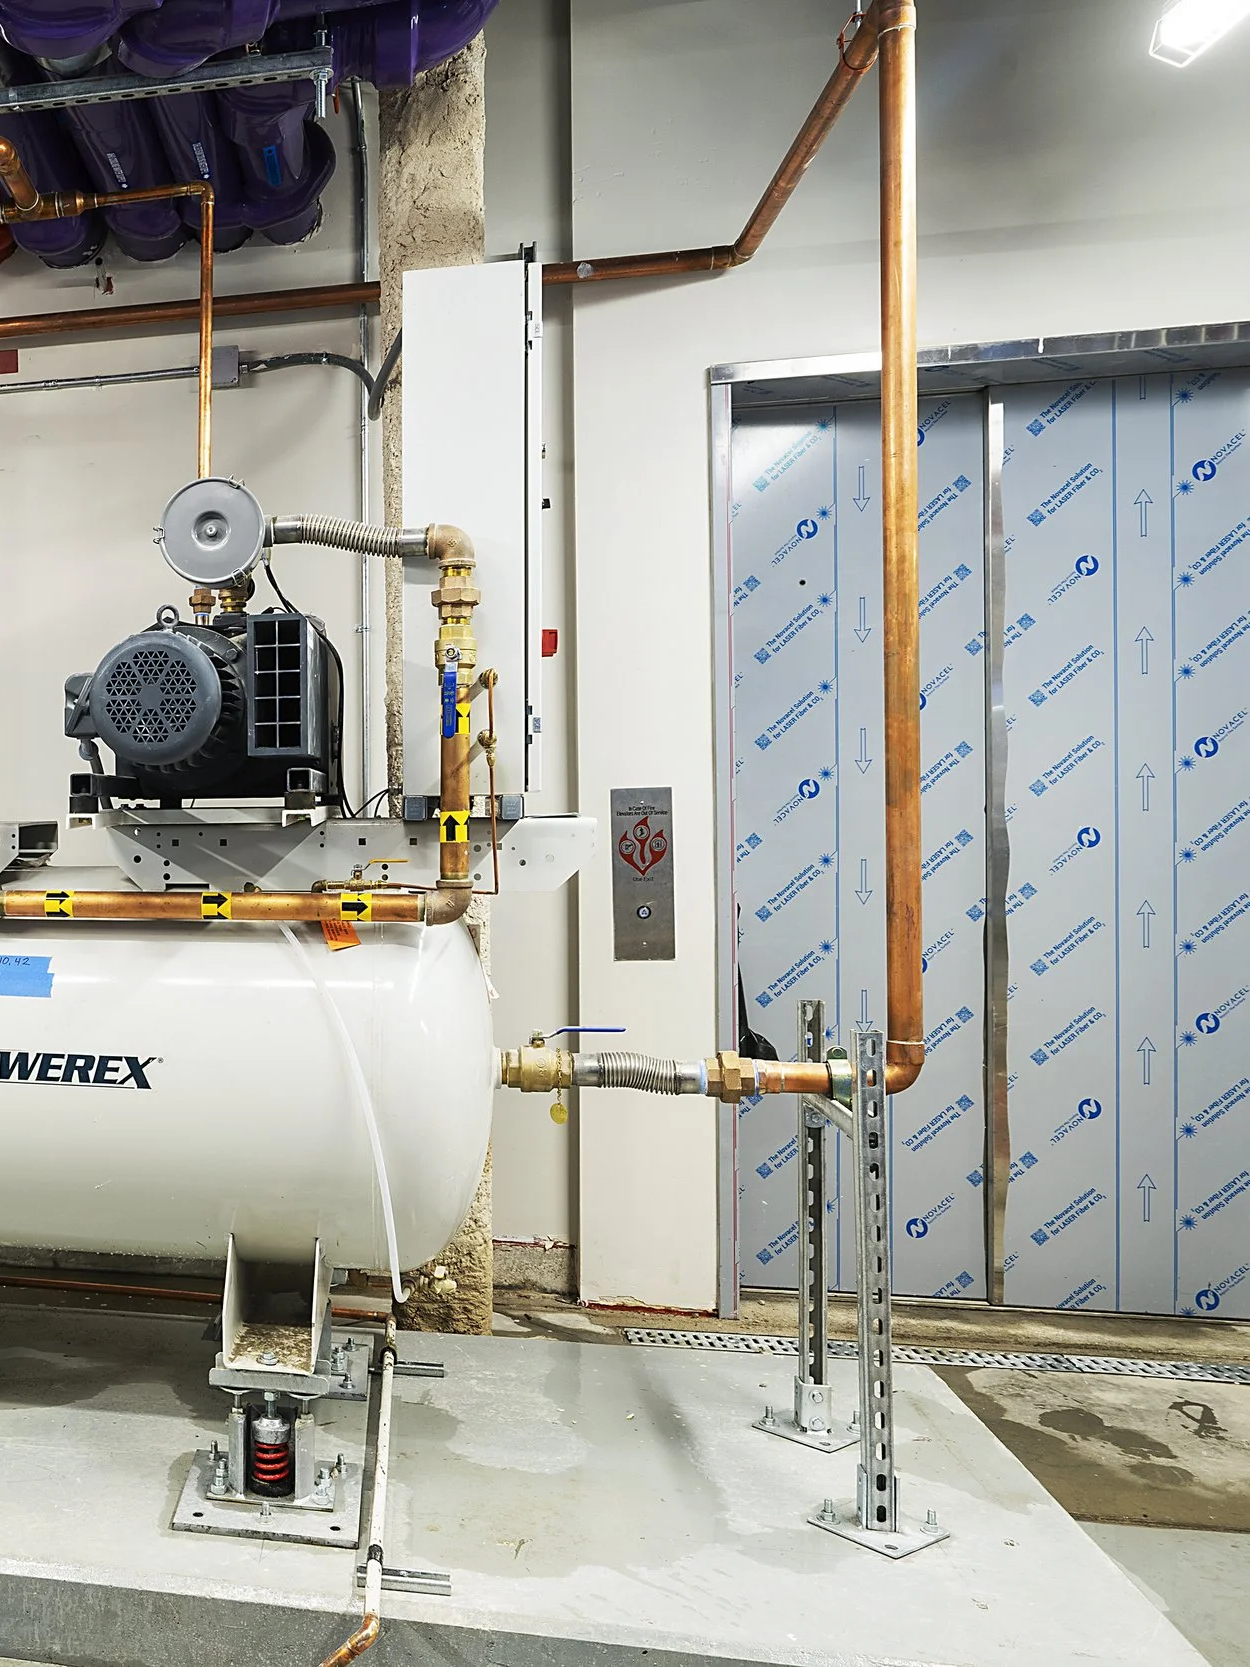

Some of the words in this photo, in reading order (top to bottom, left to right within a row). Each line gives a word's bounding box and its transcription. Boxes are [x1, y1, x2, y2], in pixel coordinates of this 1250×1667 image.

[918, 401, 951, 430] NOVACEL
[1210, 430, 1246, 463] NOVACEL
[1040, 499, 1053, 509] The
[1050, 480, 1072, 501] Novacel
[1069, 463, 1093, 483] Solution
[1047, 506, 1057, 515] for
[1055, 491, 1074, 508] LASER
[1071, 480, 1087, 493] Fiber
[1218, 529, 1238, 547] LASER
[1236, 522, 1247, 531] for
[771, 536, 802, 567] NOVACEL
[1205, 545, 1221, 558] Fiber
[1220, 537, 1244, 558] Novacel
[1199, 555, 1223, 575] Solution
[1047, 573, 1082, 605] NOVACEL
[766, 638, 777, 648] The
[775, 620, 795, 640] Novacel
[793, 604, 814, 623] Solution
[772, 645, 782, 654] for
[779, 630, 797, 647] LASER
[794, 620, 808, 633] Fiber
[921, 664, 954, 695] NOVACEL
[1041, 680, 1054, 689] The
[1051, 661, 1074, 682] Novacel
[1071, 645, 1094, 664] Solution
[1048, 687, 1058, 696] for
[1056, 672, 1076, 689] LASER
[1073, 661, 1088, 675] Fiber
[766, 724, 778, 734] The
[775, 707, 796, 726] Novacel
[793, 691, 814, 710] Solution
[772, 731, 782, 740] for
[780, 717, 798, 734] LASER
[795, 707, 809, 720] Fiber
[1212, 708, 1248, 740] NOVACEL
[928, 758, 946, 775] LASER
[944, 752, 954, 761] for
[948, 758, 960, 768] The
[1042, 770, 1055, 779] The
[1051, 752, 1074, 772] Novacel
[1071, 735, 1095, 755] Solution
[1049, 777, 1059, 786] for
[1057, 762, 1076, 779] LASER
[1073, 752, 1089, 765] Fiber
[930, 766, 951, 785] Novacel
[773, 796, 804, 826] NOVACEL
[1049, 845, 1084, 876] NOVACEL
[767, 896, 779, 906] The
[776, 879, 796, 898] Novacel
[794, 864, 815, 883] Solution
[773, 904, 783, 912] for
[780, 889, 798, 906] LASER
[795, 880, 810, 892] Fiber
[1238, 893, 1249, 902] for
[1207, 914, 1224, 927] Fiber
[1221, 899, 1241, 917] LASER
[1223, 907, 1246, 928] Novacel
[922, 928, 955, 959] NOVACEL
[1043, 950, 1056, 959] The
[1053, 932, 1075, 952] Novacel
[1072, 916, 1096, 935] Solution
[1050, 957, 1060, 966] for
[1058, 943, 1077, 959] LASER
[1074, 932, 1090, 945] Fiber
[1201, 924, 1225, 944] Solution
[767, 982, 779, 992] The
[776, 966, 797, 985] Novacel
[794, 950, 816, 969] Solution
[774, 990, 783, 998] for
[781, 976, 799, 992] LASER
[796, 966, 810, 979] Fiber
[1214, 986, 1250, 1016] NOVACEL
[1043, 1040, 1056, 1049] The
[1053, 1022, 1076, 1042] Novacel
[1073, 1007, 1096, 1025] Solution
[1050, 1047, 1061, 1056] for
[1058, 1033, 1078, 1049] LASER
[1074, 1023, 1090, 1036] Fiber
[929, 1111, 948, 1127] LASER
[945, 1105, 955, 1113] for
[949, 1112, 962, 1121] The
[911, 1134, 933, 1152] Solution
[917, 1124, 932, 1137] Fiber
[931, 1119, 952, 1137] Novacel
[1050, 1116, 1084, 1146] NOVACEL
[768, 1154, 779, 1163] The
[776, 1137, 797, 1156] Novacel
[774, 1161, 783, 1170] for
[782, 1146, 799, 1163] LASER
[924, 1193, 955, 1222] NOVACEL
[1043, 1220, 1056, 1229] The
[1053, 1203, 1076, 1222] Novacel
[1073, 1188, 1096, 1206] Solution
[1050, 1227, 1061, 1236] for
[1058, 1214, 1078, 1230] LASER
[1075, 1204, 1091, 1217] Fiber
[1213, 1264, 1250, 1293] NOVACEL
